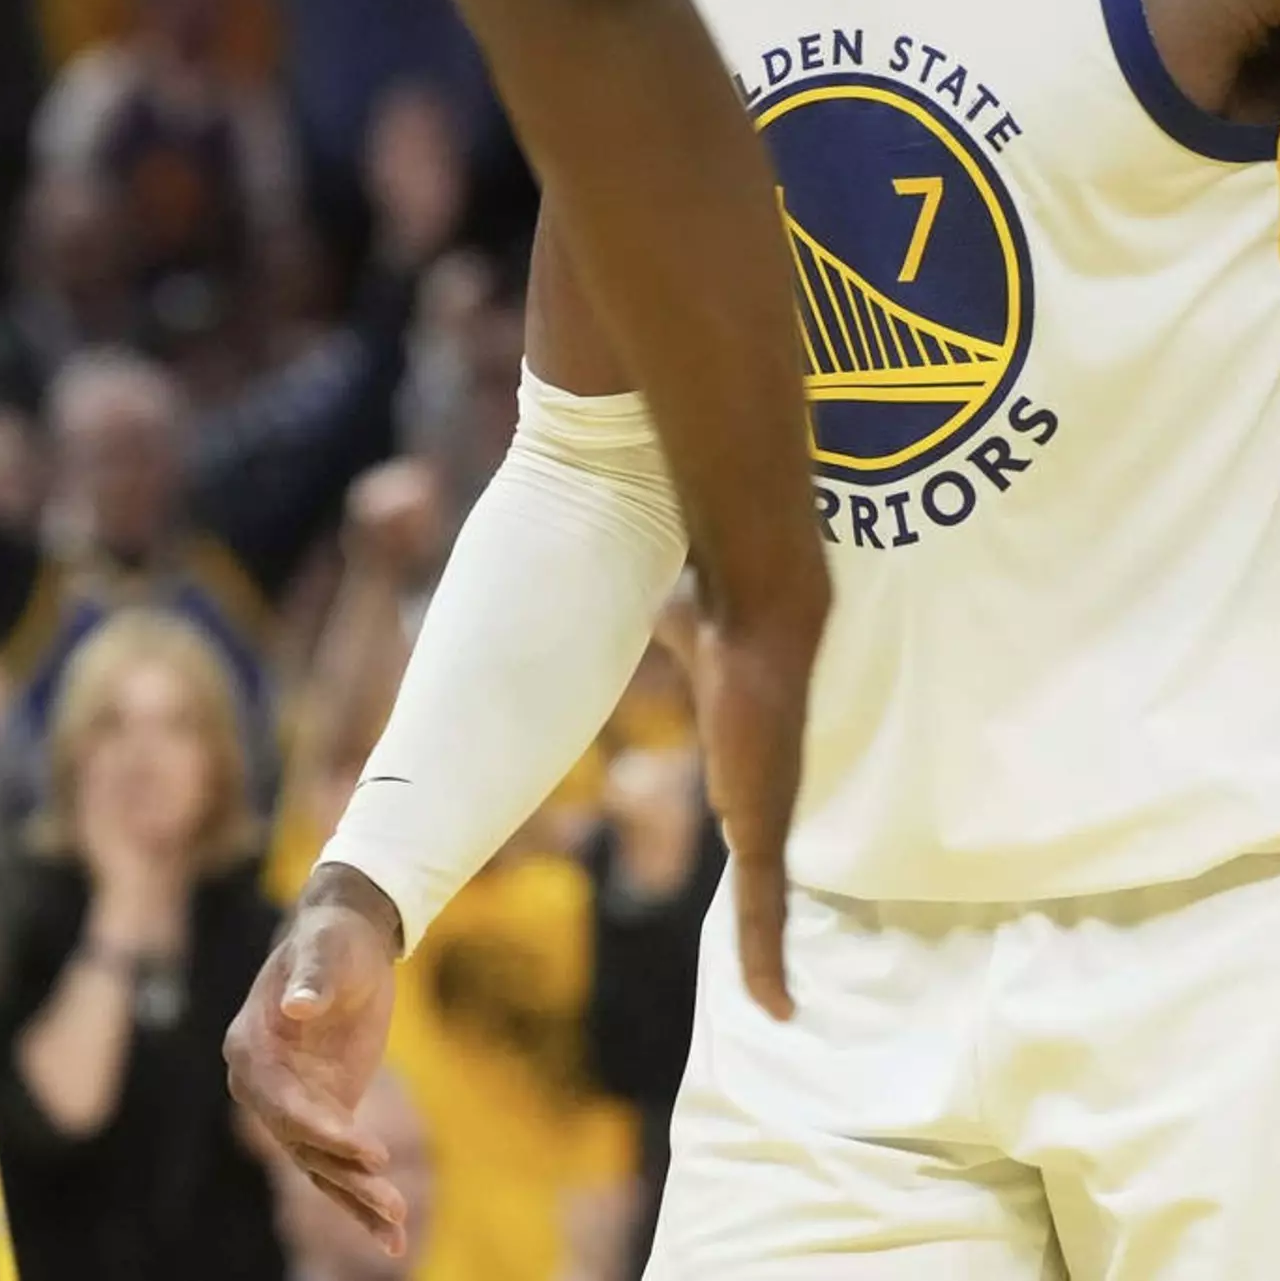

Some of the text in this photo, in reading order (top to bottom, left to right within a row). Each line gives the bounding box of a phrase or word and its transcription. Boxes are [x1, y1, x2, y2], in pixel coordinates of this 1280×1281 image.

[732, 29, 1022, 152] LDEN STATE
[891, 176, 945, 283] 7
[811, 395, 1058, 550] RRIORS
